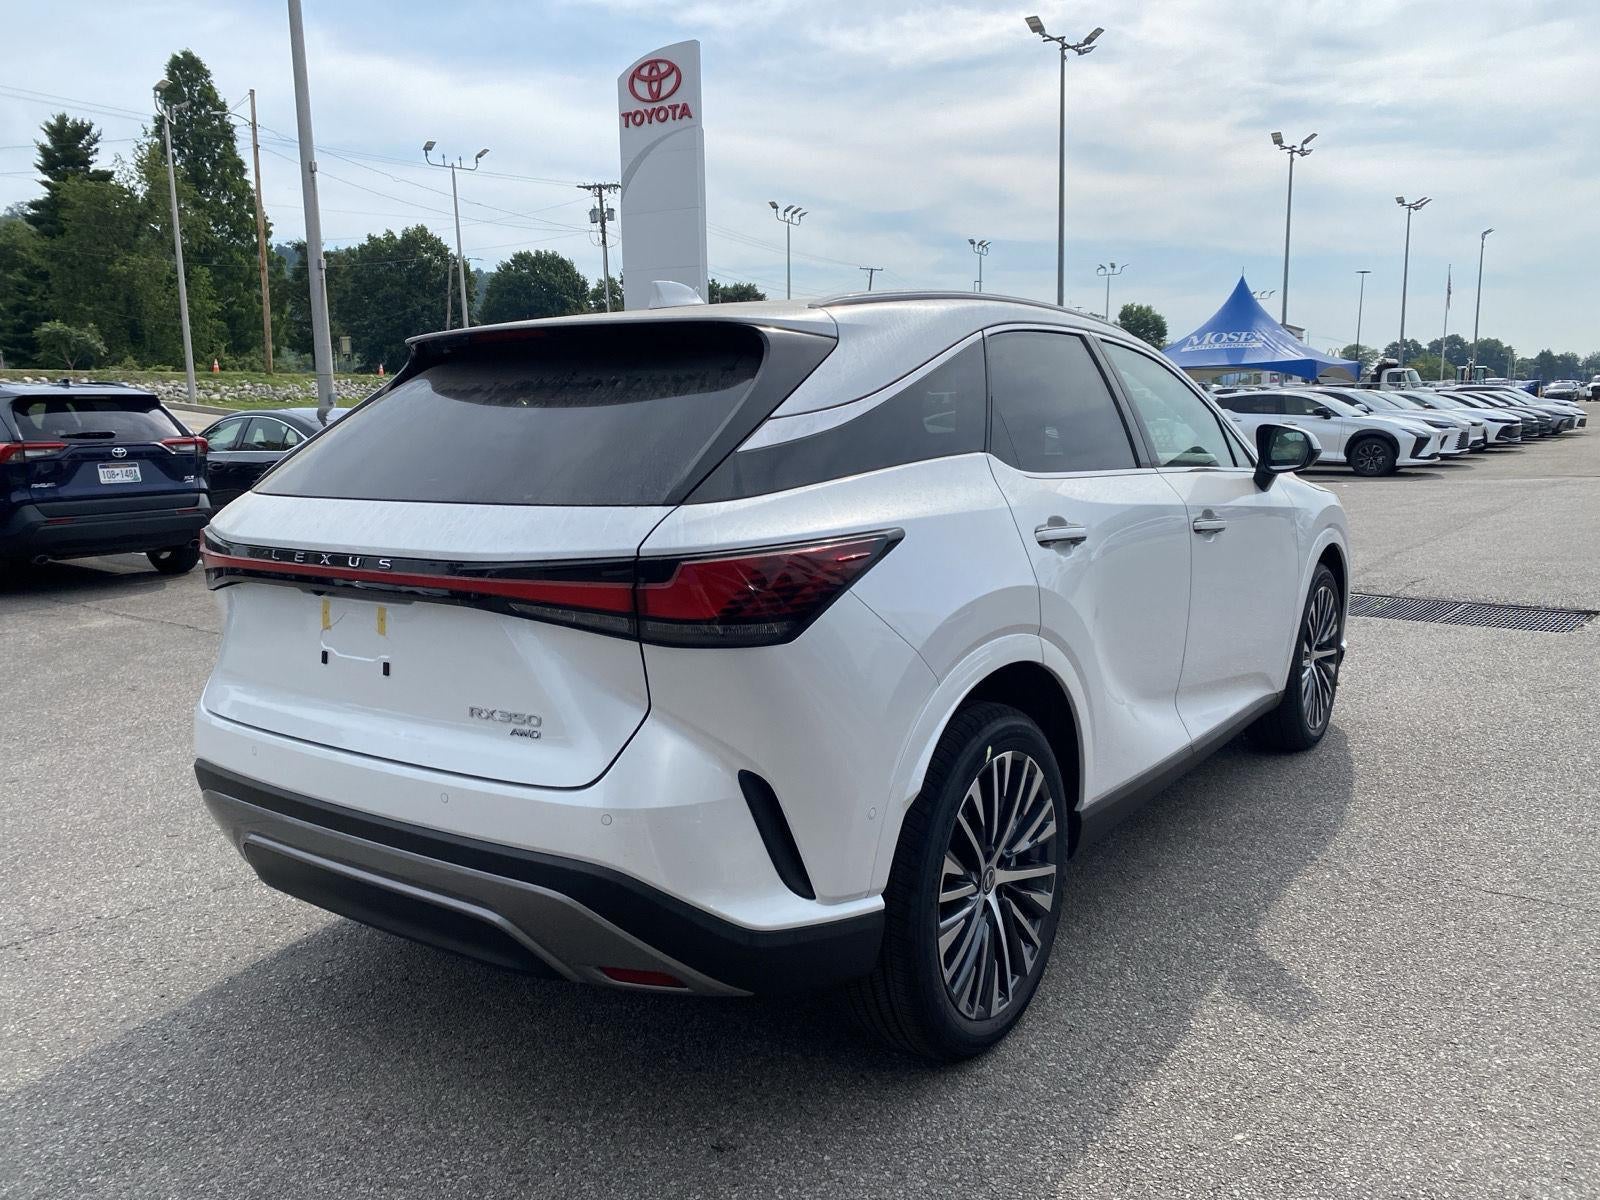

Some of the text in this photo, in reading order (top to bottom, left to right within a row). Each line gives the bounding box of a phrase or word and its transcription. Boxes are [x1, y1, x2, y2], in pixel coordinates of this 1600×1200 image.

[621, 102, 692, 128] TOYOTA
[272, 549, 392, 570] LEXUS
[469, 706, 542, 727] RX350
[510, 728, 542, 740] AWD
